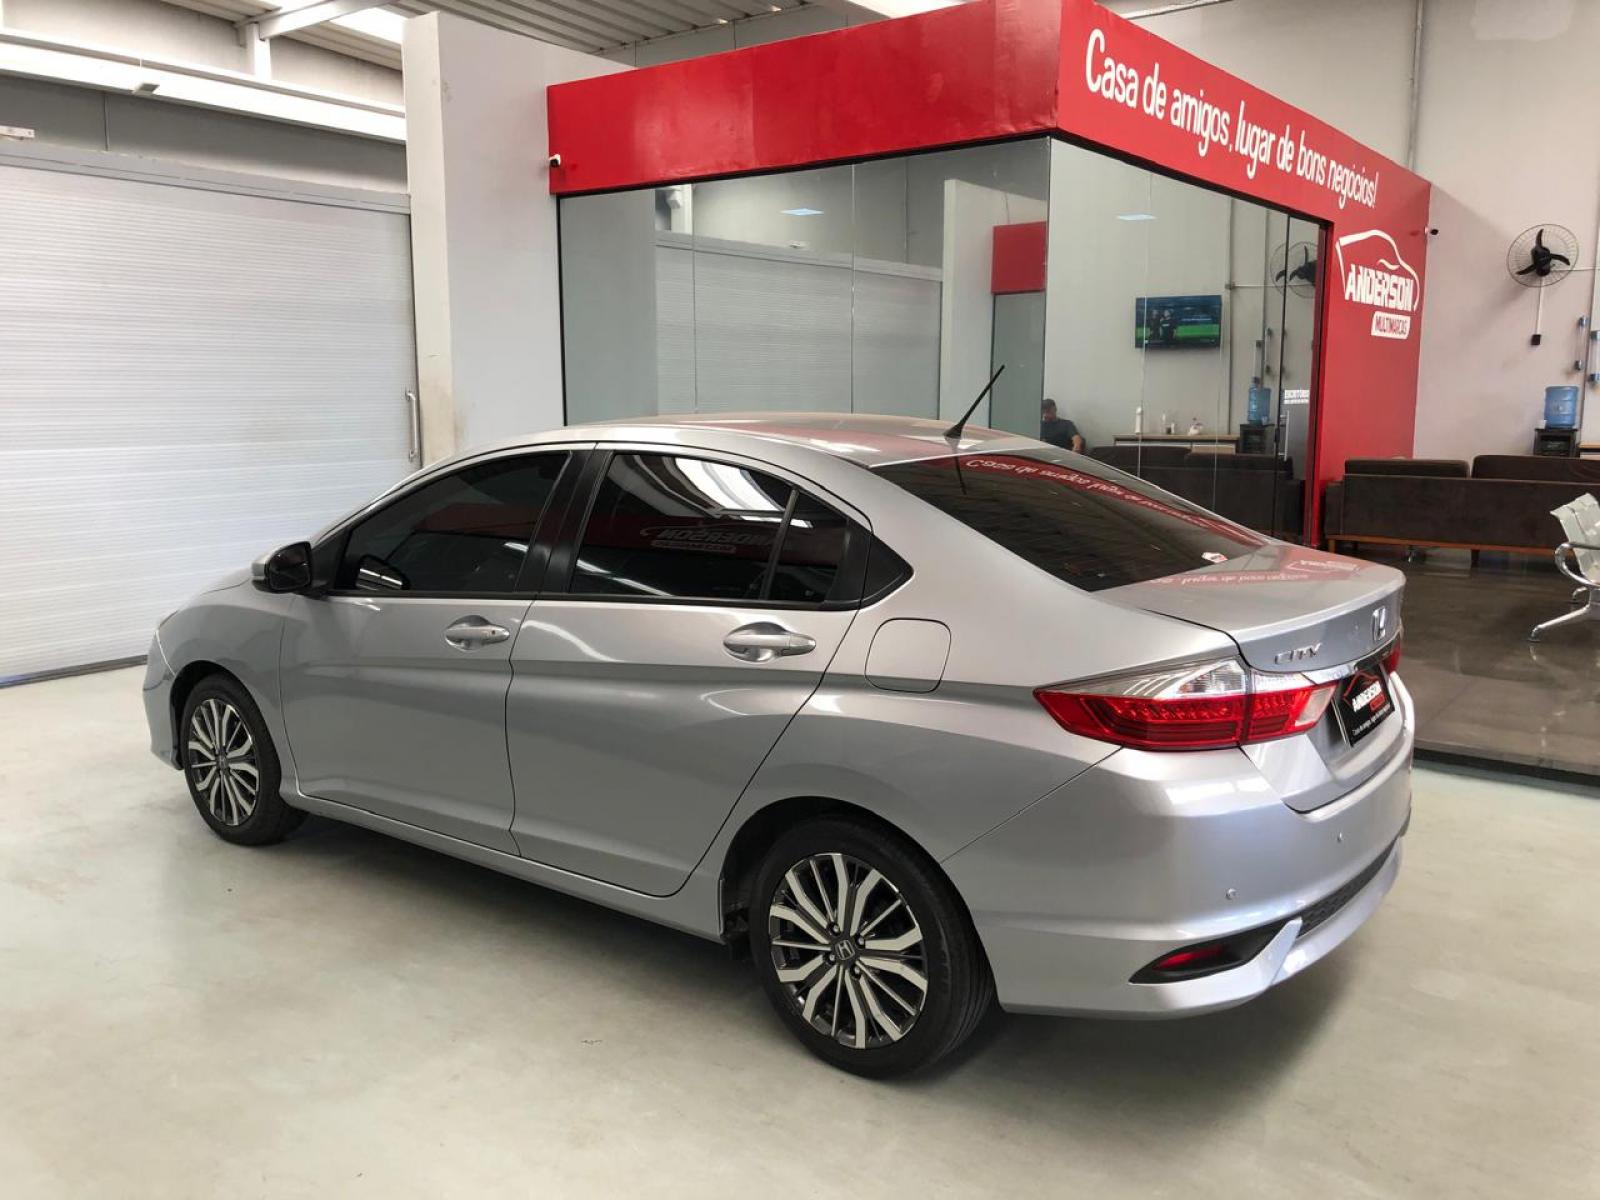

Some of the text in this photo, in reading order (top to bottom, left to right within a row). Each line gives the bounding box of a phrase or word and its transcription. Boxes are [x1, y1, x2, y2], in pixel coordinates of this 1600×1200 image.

[1085, 28, 1379, 210] Casa de amigos, lugar de bons negócios!
[1345, 263, 1414, 312] ANDERSON
[1274, 642, 1322, 665] CITY
